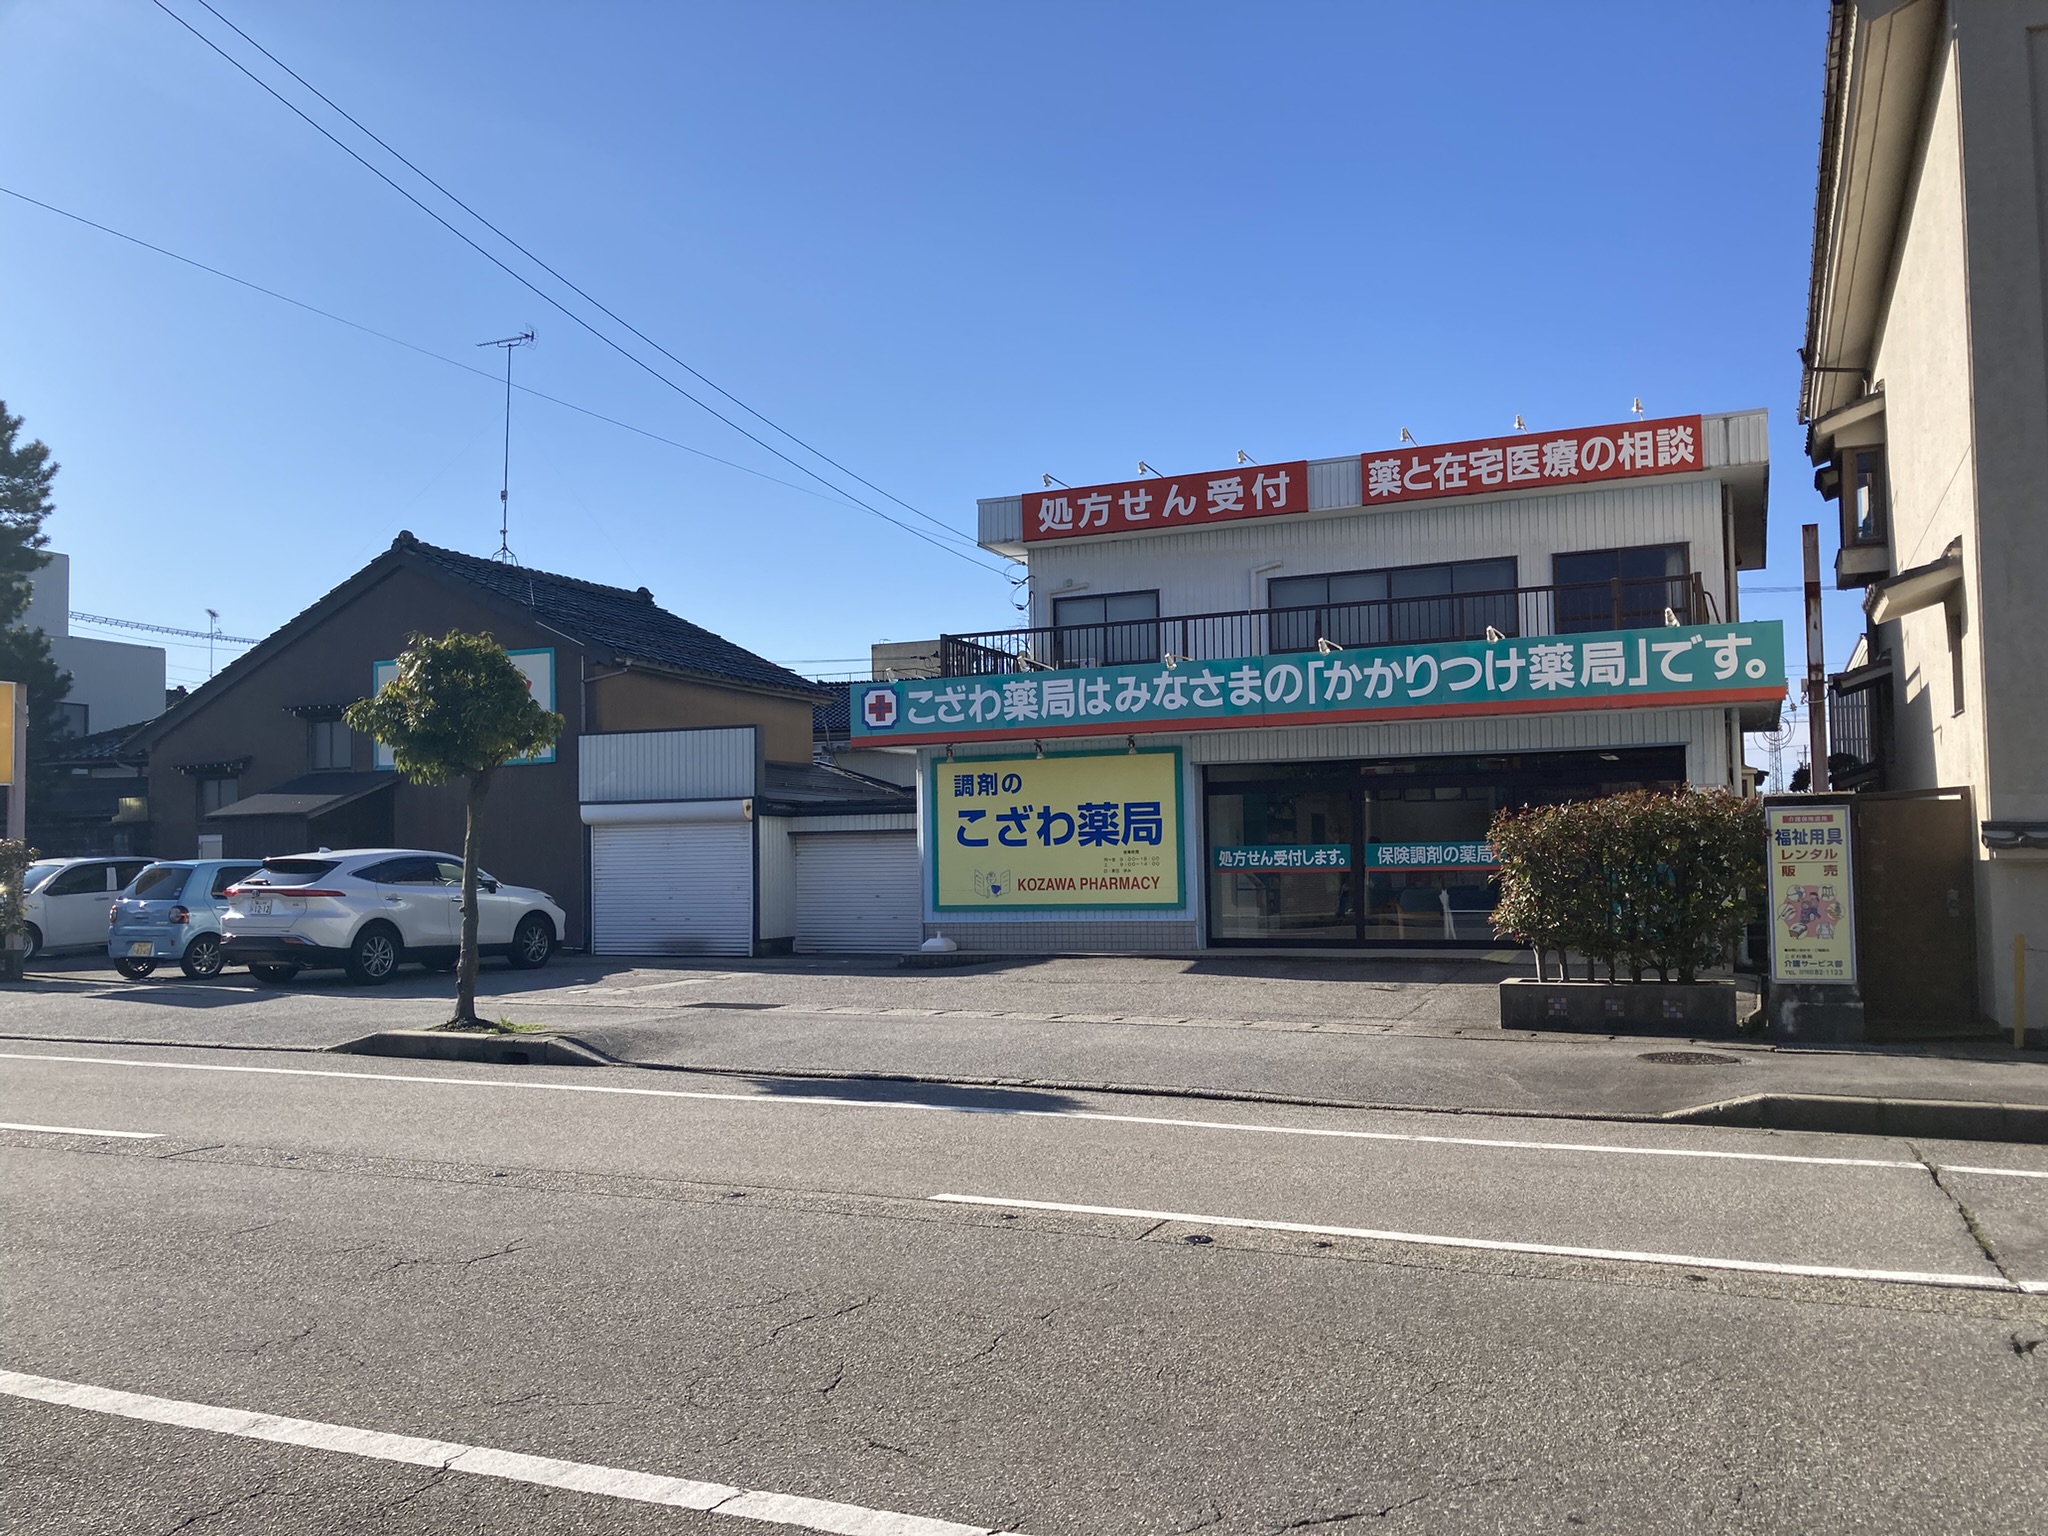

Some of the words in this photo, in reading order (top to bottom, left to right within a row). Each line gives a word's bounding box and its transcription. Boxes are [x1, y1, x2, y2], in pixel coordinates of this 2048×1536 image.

[1367, 425, 1695, 498] 薬と在宅医療の相談
[1037, 470, 1291, 533] 処方せん受付
[907, 632, 1767, 725] こざわ薬局はみなさまの「かかりつけ薬局」です。
[954, 773, 1023, 798] 調剤の
[956, 801, 1163, 847] こざわ薬局
[1775, 828, 1843, 846] 福祉用具
[1218, 848, 1346, 867] 処方せん受付します。
[1377, 844, 1493, 865] 保険調剤の薬局
[1781, 848, 1838, 860] レンタル
[1017, 877, 1076, 891] KOZAWA
[1080, 876, 1160, 891] PHARMACY
